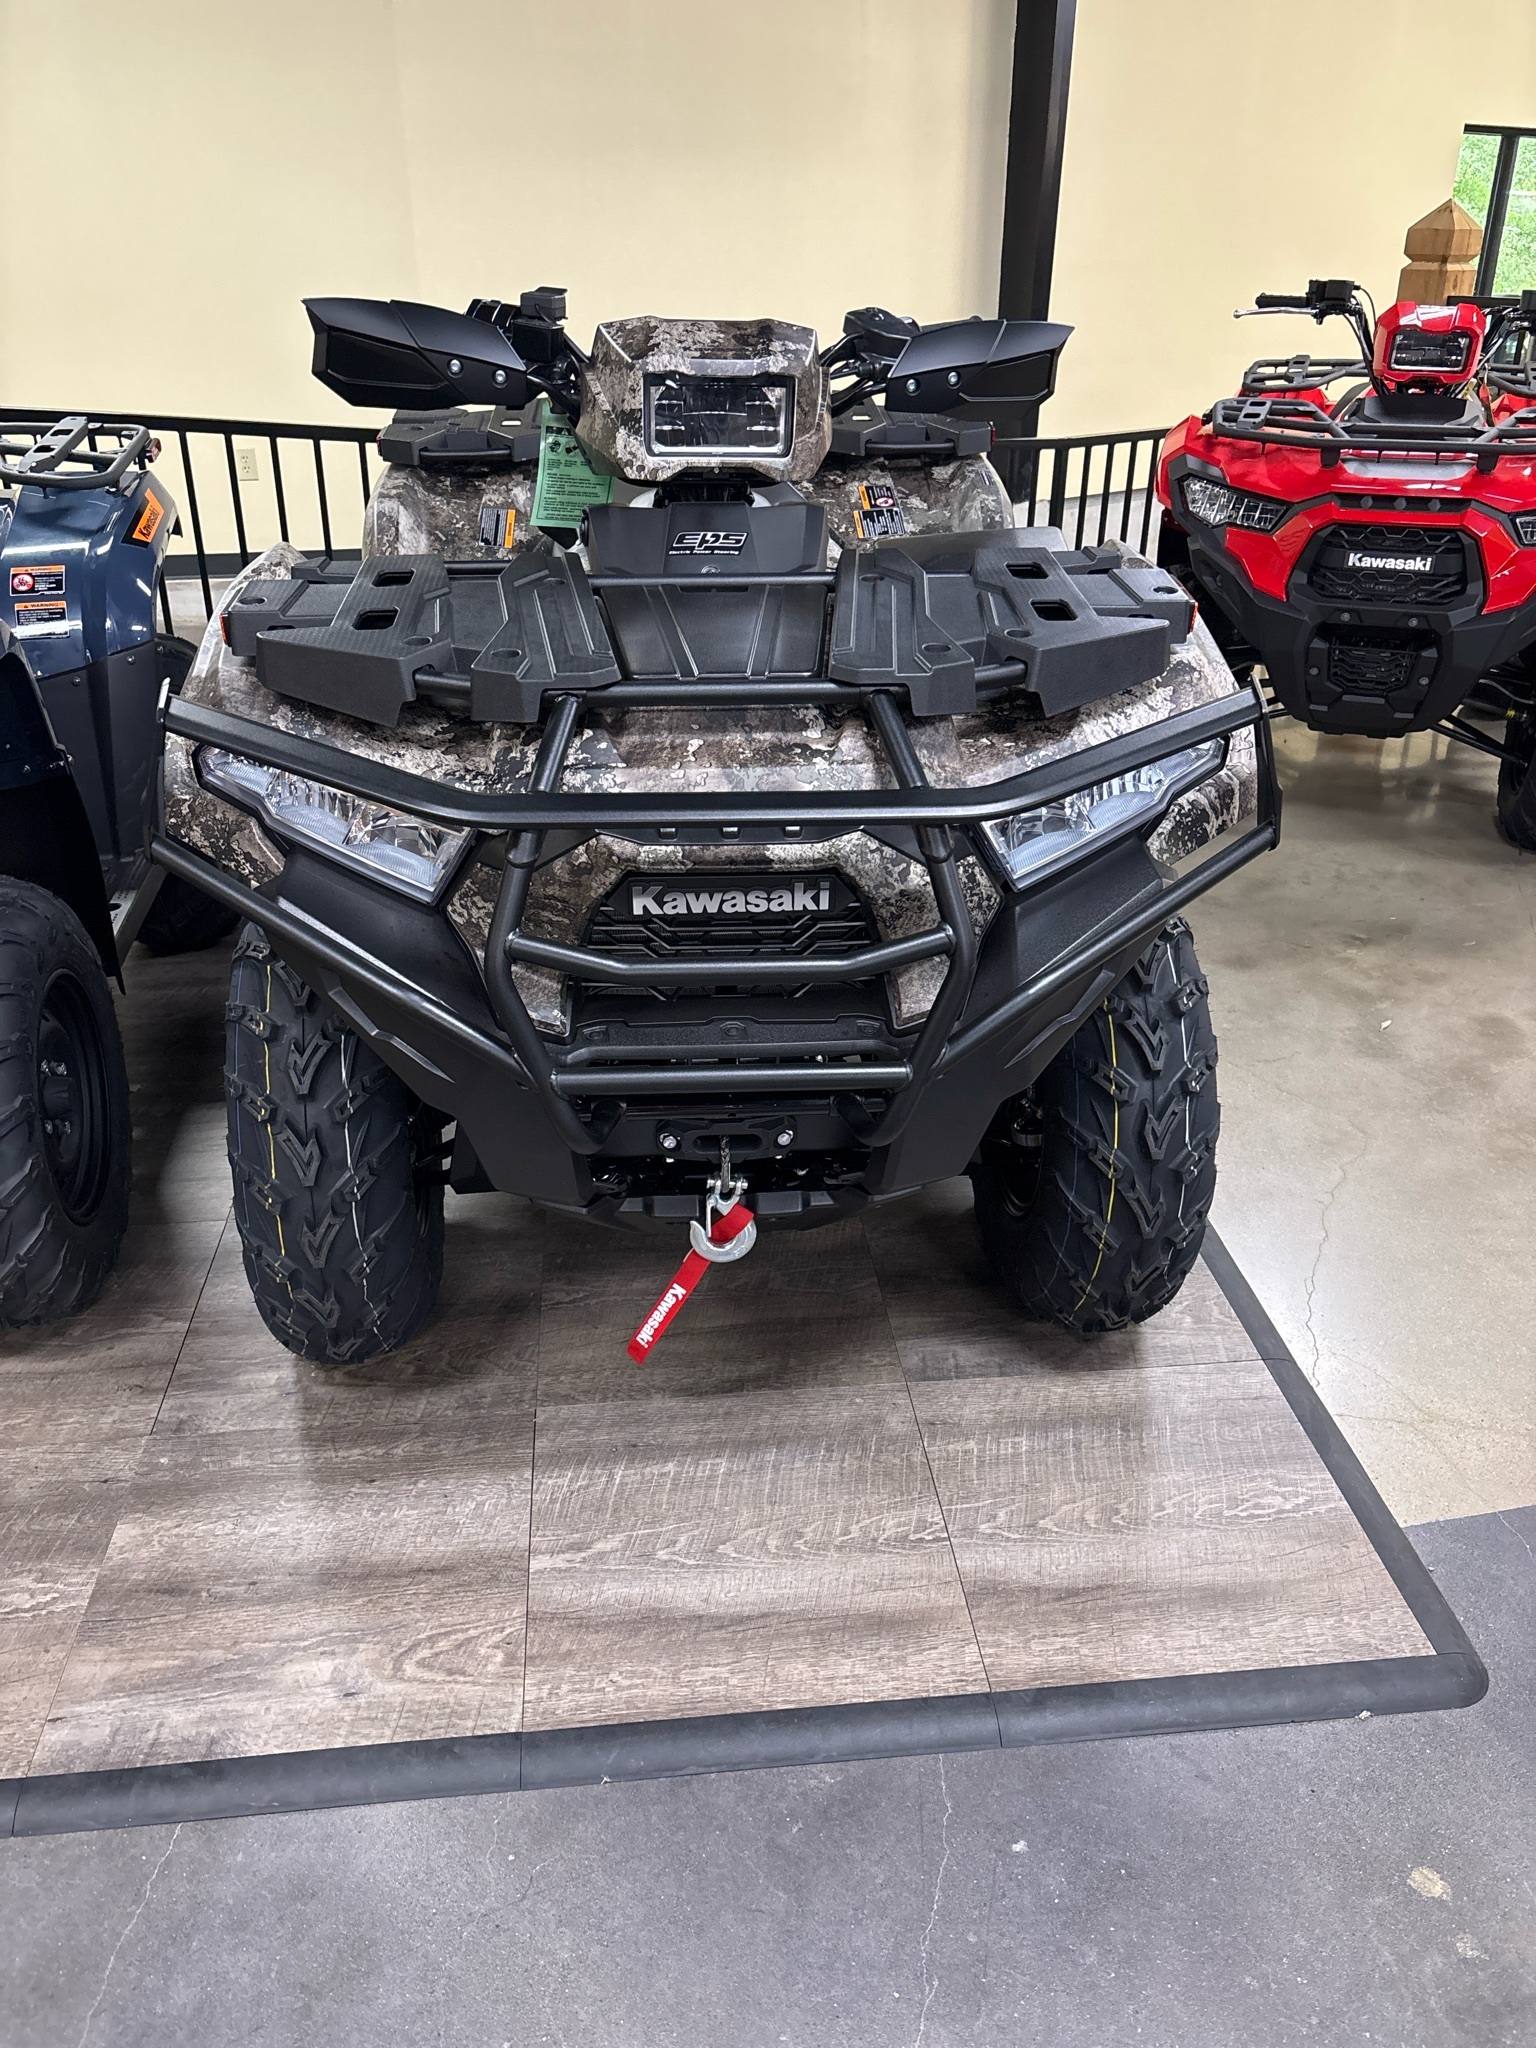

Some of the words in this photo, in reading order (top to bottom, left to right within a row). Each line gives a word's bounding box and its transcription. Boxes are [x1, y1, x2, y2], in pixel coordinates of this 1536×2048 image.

[1347, 552, 1433, 572] Kawasaki
[631, 881, 830, 916] Kawasaki
[635, 1282, 687, 1349] Kawasaki
